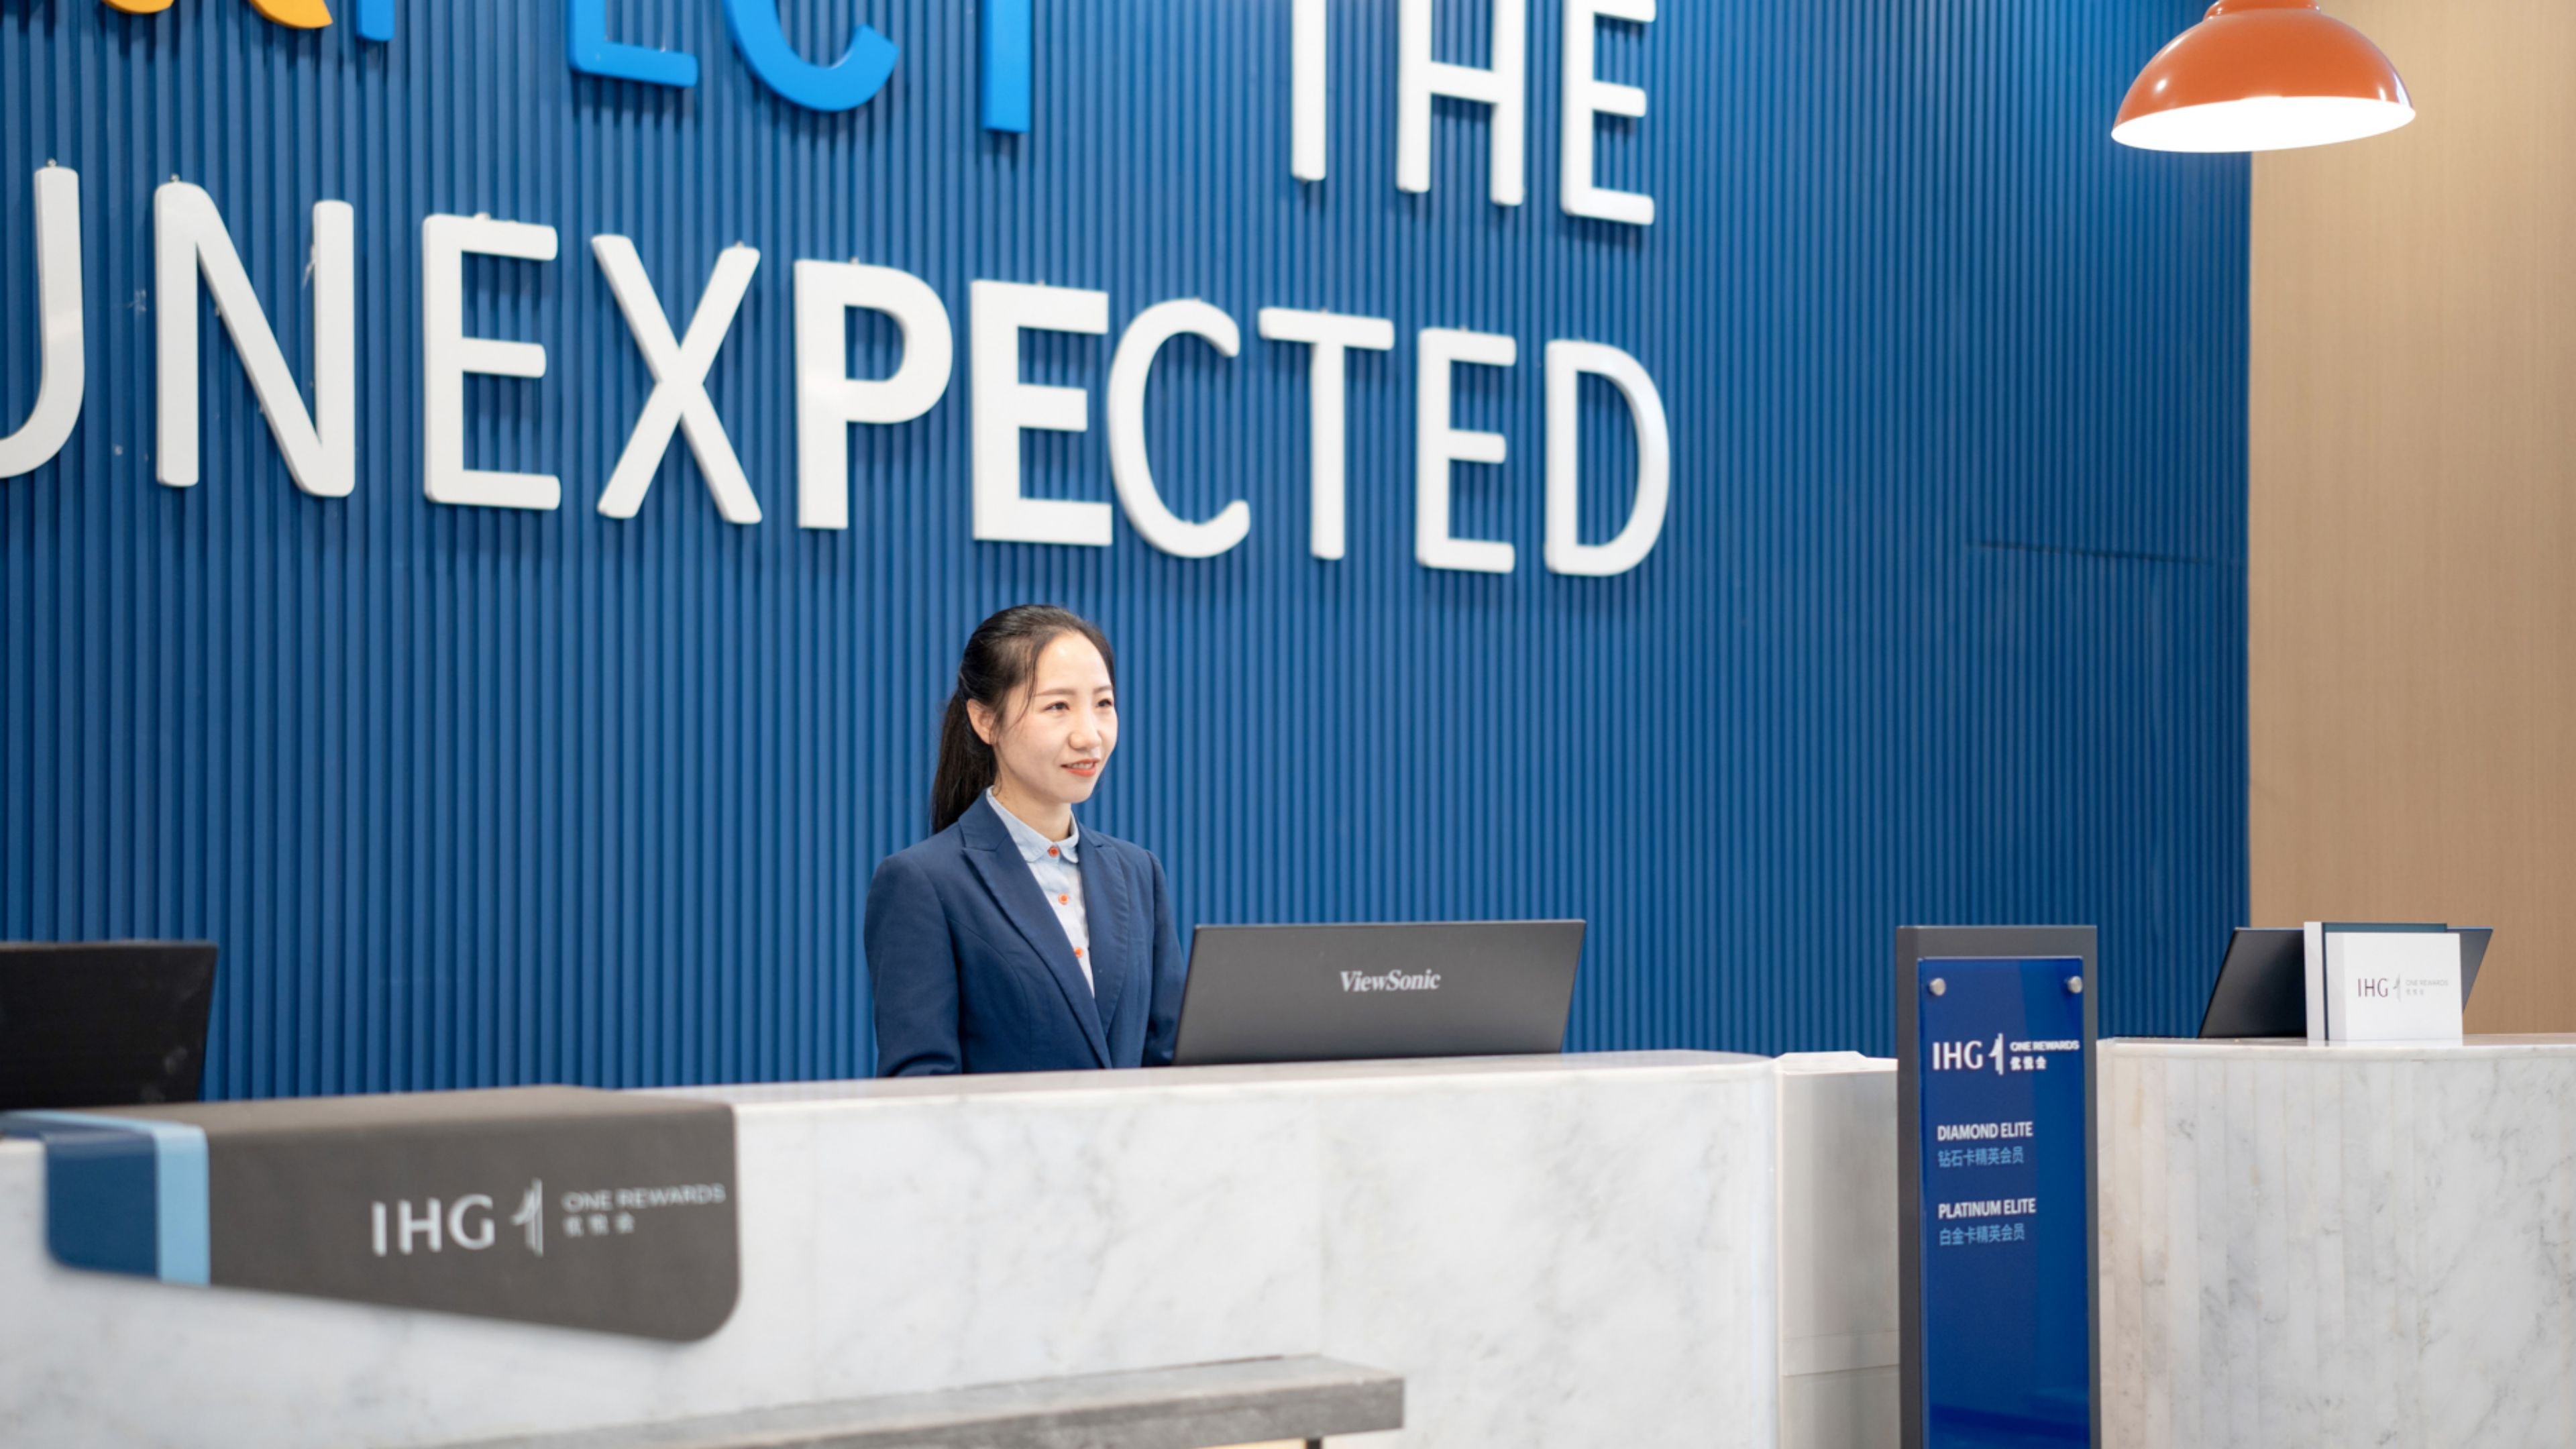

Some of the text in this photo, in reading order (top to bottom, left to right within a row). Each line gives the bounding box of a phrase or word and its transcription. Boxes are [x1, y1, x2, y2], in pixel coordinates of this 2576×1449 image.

[1340, 968, 1441, 993] ViewSonic
[2357, 977, 2388, 998] IHG
[1933, 1040, 1984, 1071] IHG
[2009, 1040, 2080, 1052] ONE REWARDS
[1937, 1121, 2033, 1141] DIAMOND ELITE
[1937, 1146, 2025, 1168] 钻石卡精英会员
[561, 1183, 727, 1214] ONE REWARDS
[1938, 1197, 2037, 1220] PLATINUM ELITE
[371, 1193, 496, 1257] IHG
[1939, 1222, 2025, 1246] 白金卡精英会员
